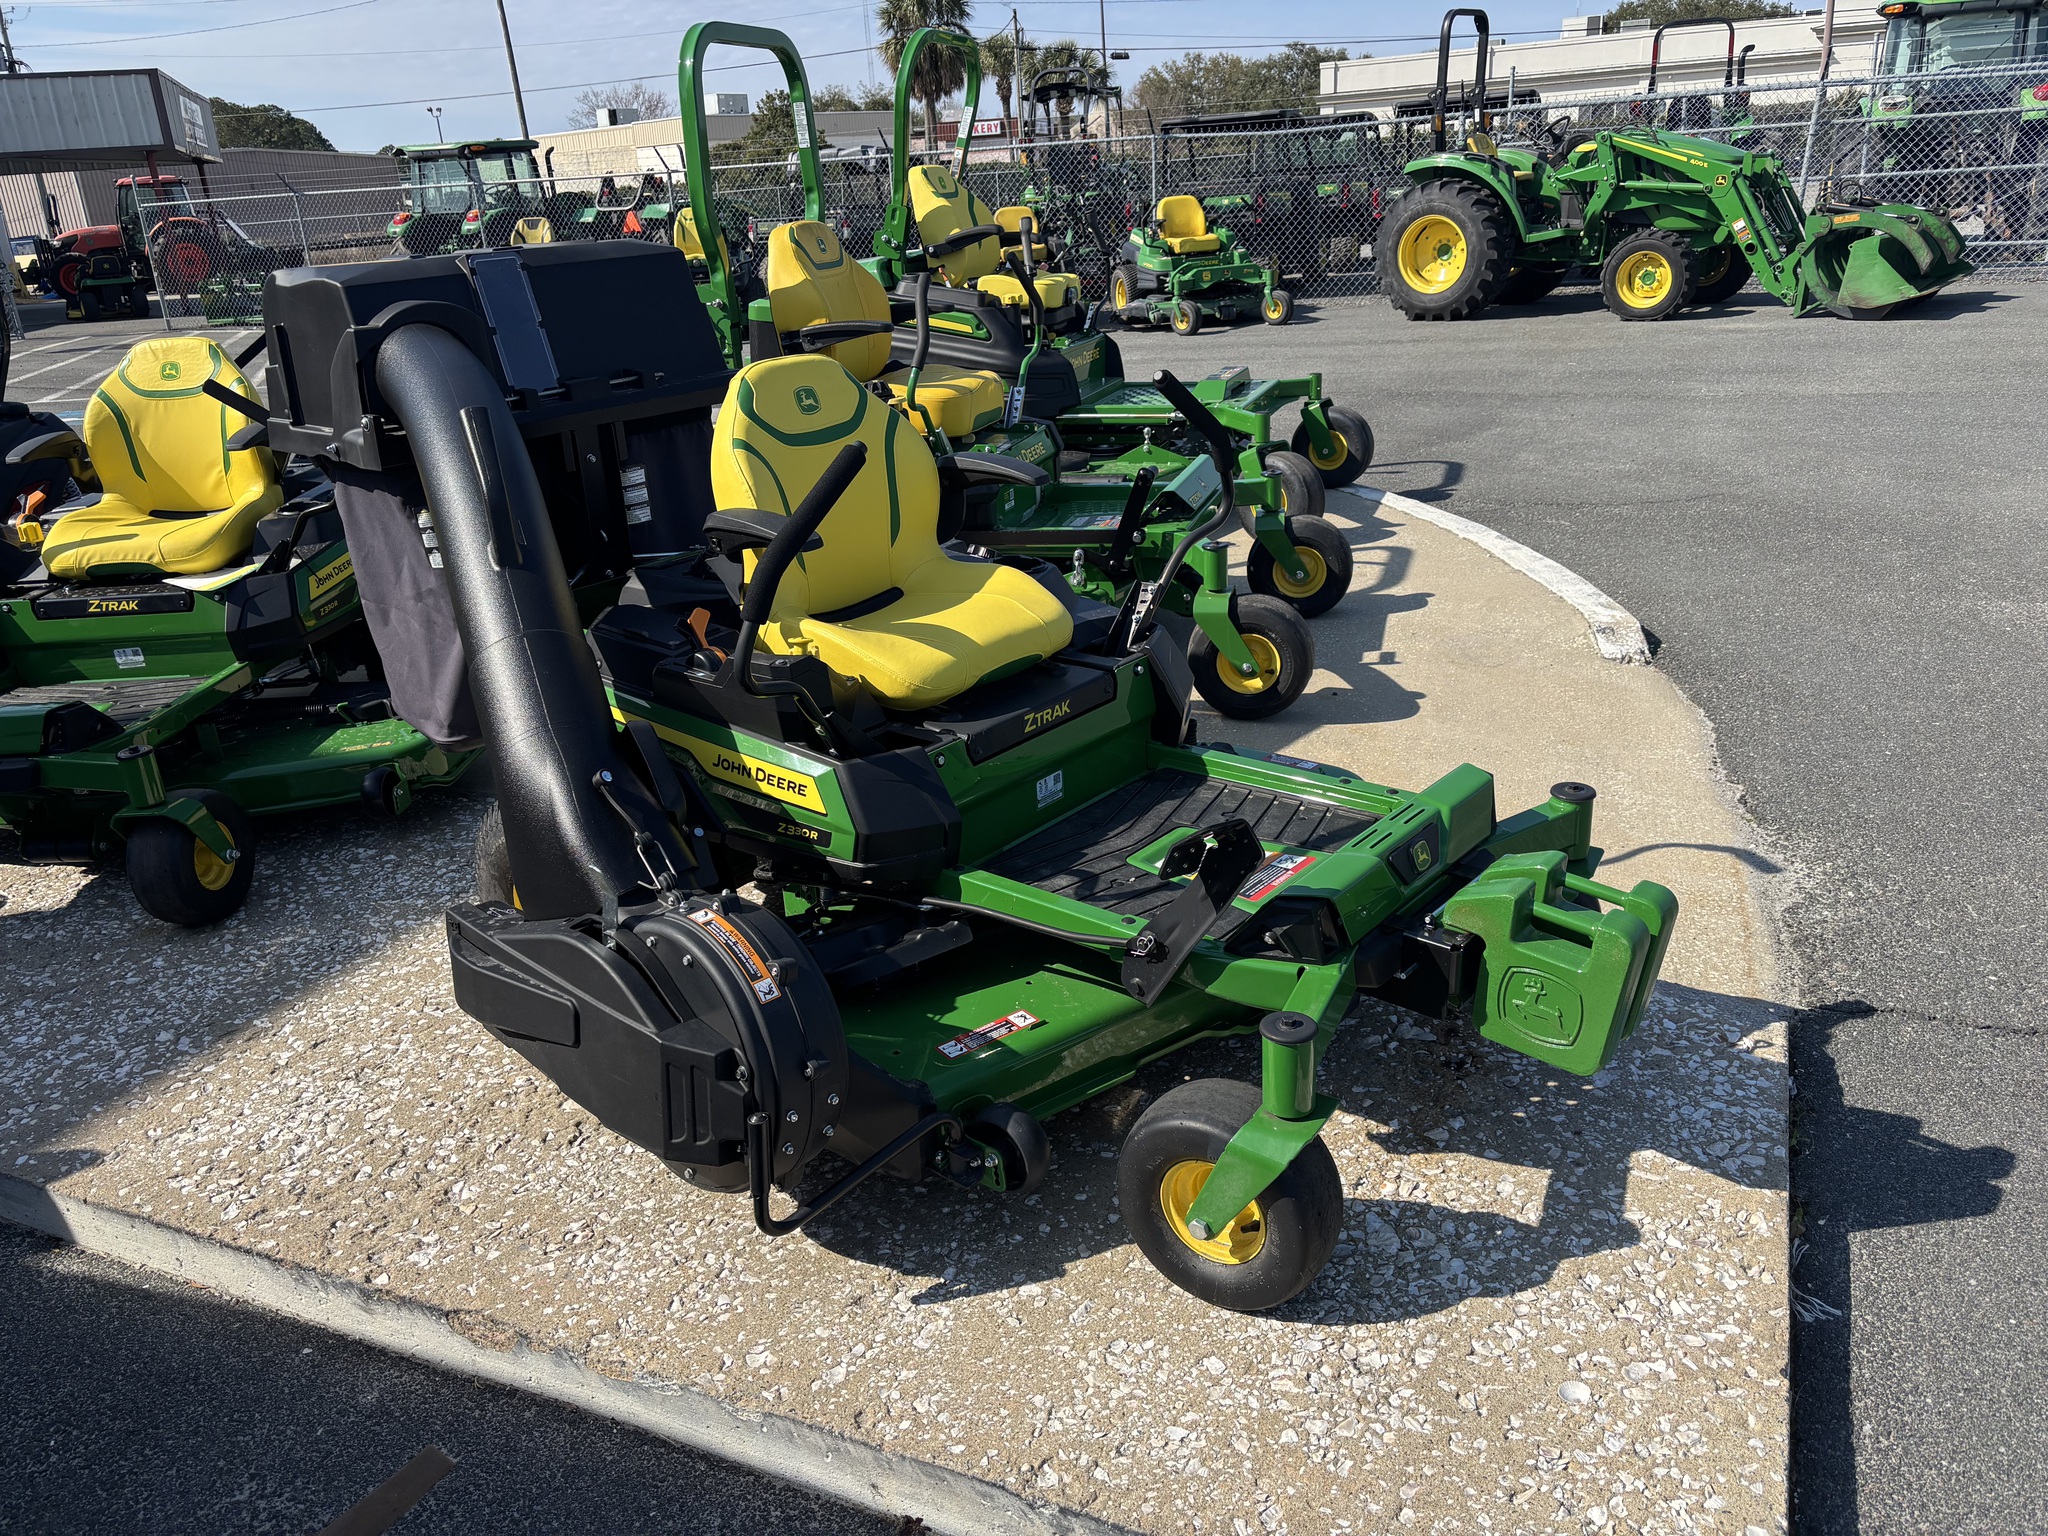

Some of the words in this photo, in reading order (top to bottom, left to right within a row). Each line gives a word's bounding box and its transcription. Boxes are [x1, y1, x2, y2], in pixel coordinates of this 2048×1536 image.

[973, 122, 999, 135] KERY
[1083, 347, 1100, 365] DEERE
[1020, 441, 1047, 463] DEERE
[314, 570, 335, 589] JOHN
[332, 557, 353, 576] DEER
[88, 600, 139, 612] ZTRAK
[1024, 699, 1070, 733] ZTRAK
[712, 754, 752, 779] JOHN
[755, 767, 808, 797] DEERE
[777, 822, 819, 840] Z330R
